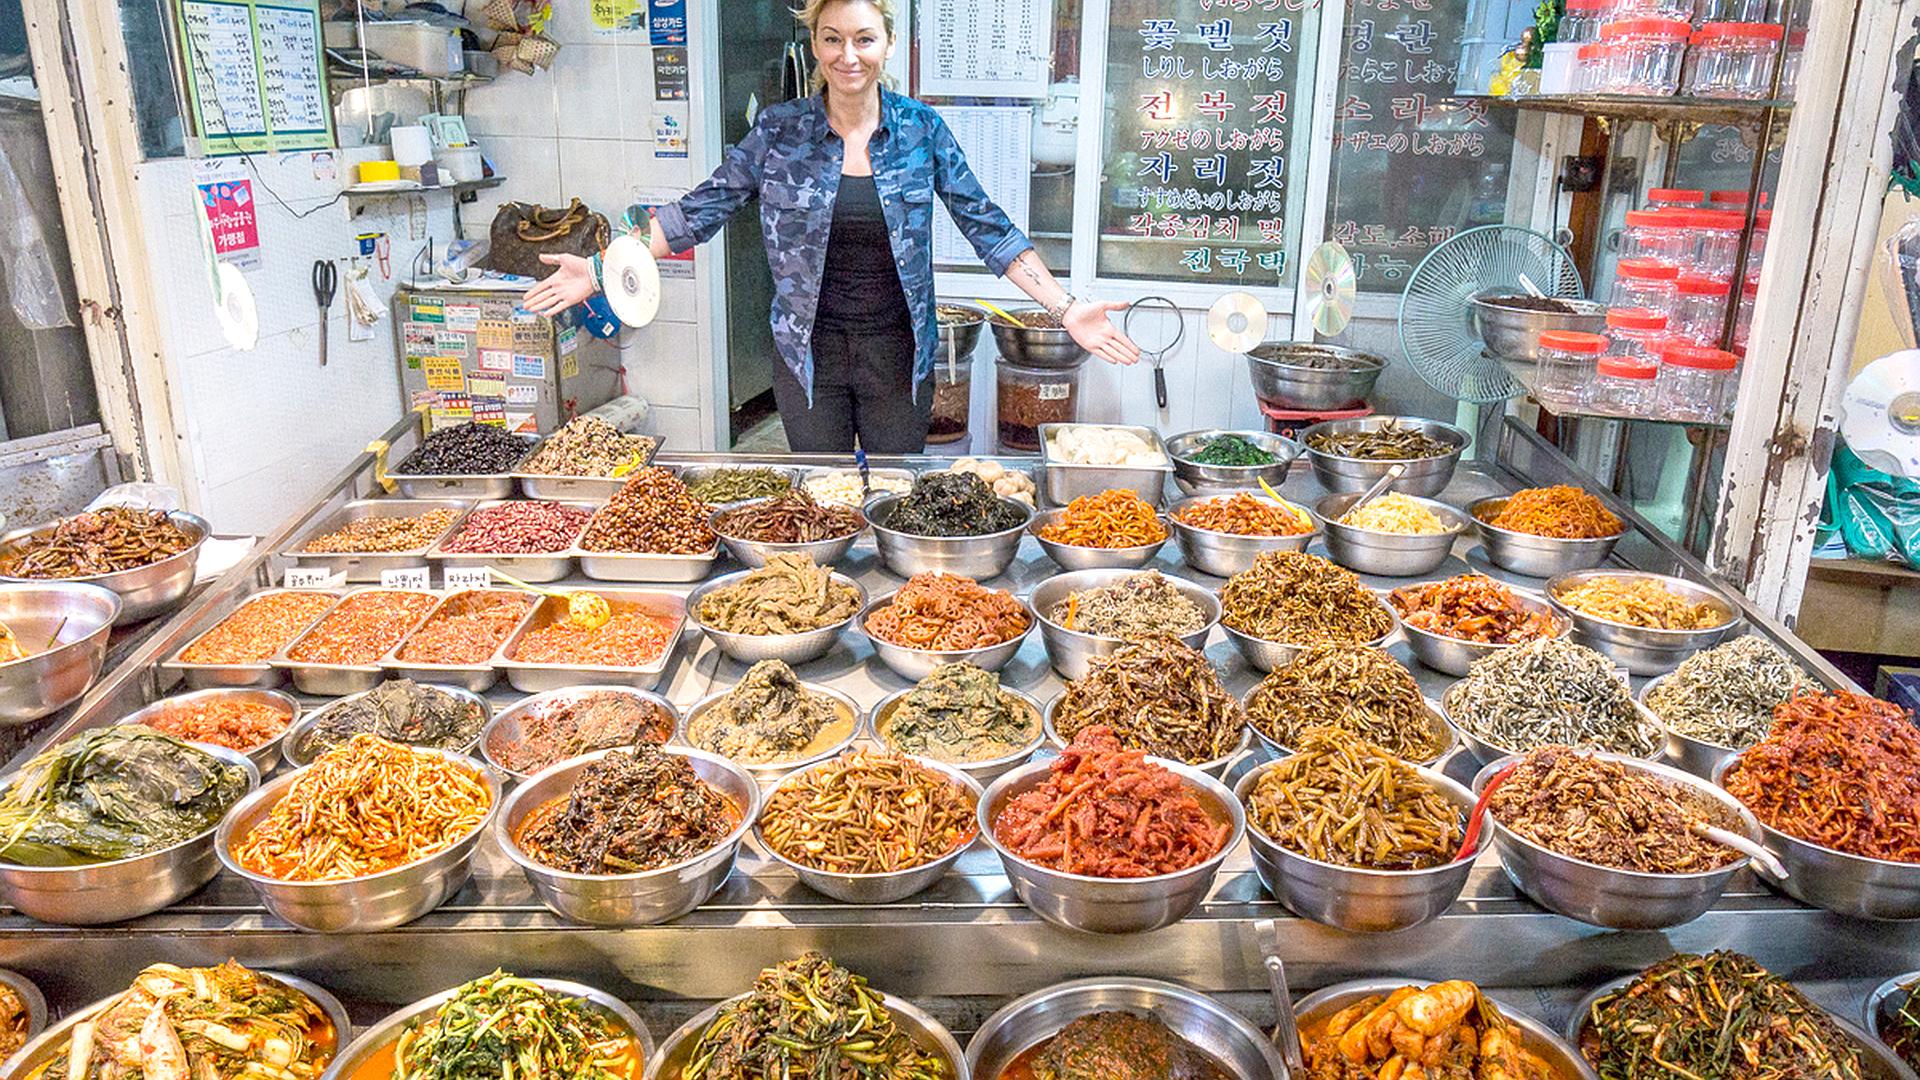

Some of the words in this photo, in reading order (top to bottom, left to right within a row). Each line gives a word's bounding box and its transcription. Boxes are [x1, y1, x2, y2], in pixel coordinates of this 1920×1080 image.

[653, 17, 683, 29] 삼성카드
[1202, 56, 1284, 82] しおがら
[1129, 212, 1240, 242] 각종김치
[1257, 217, 1283, 244] 및
[219, 231, 246, 246] 가맹점
